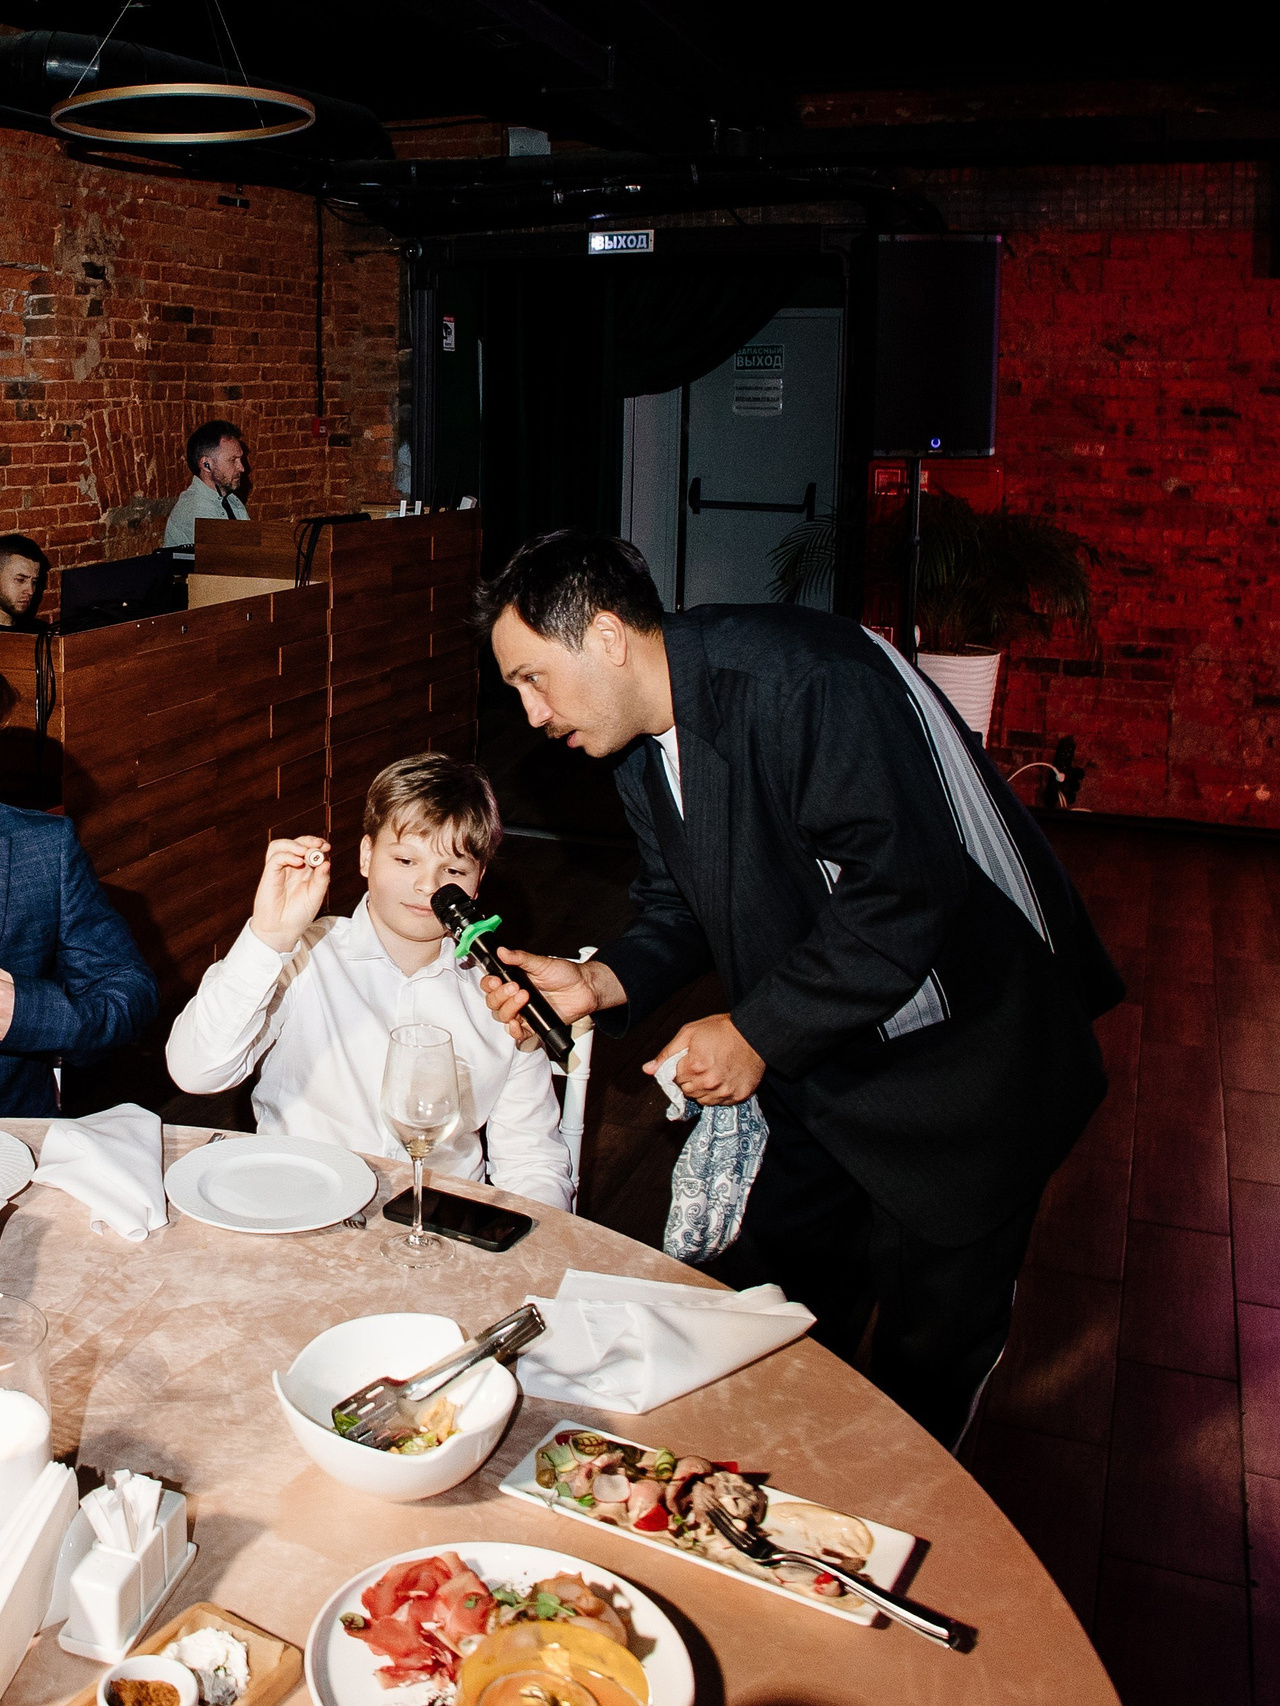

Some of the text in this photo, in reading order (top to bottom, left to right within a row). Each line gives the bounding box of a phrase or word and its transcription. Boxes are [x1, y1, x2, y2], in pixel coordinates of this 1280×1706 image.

[593, 234, 647, 250] ВЫХОД
[737, 346, 782, 355] ЗАПАСНЫЙ
[736, 355, 782, 368] ВЫХОД
